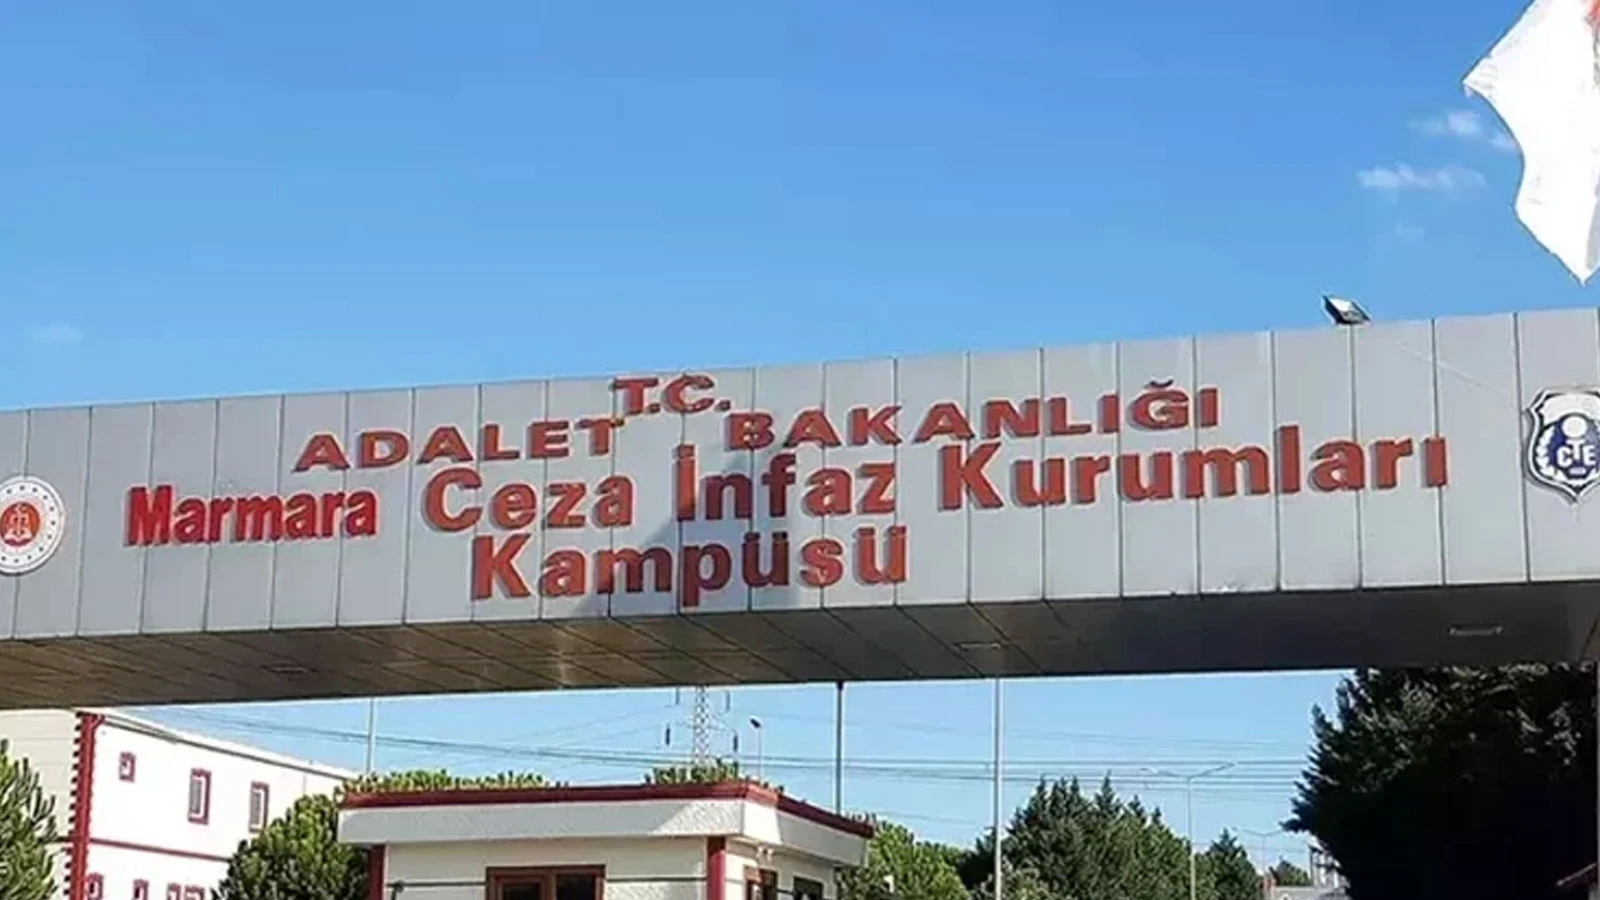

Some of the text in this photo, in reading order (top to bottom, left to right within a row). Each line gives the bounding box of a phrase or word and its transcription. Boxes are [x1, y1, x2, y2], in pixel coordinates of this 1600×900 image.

[294, 380, 1220, 472] ADALET BAKANLIĞI
[612, 374, 731, 414] T.C.
[125, 425, 1449, 546] Marmara Ceza İnfaz Kurumları
[1556, 438, 1597, 467] CTE
[471, 525, 908, 607] Kampüsü
